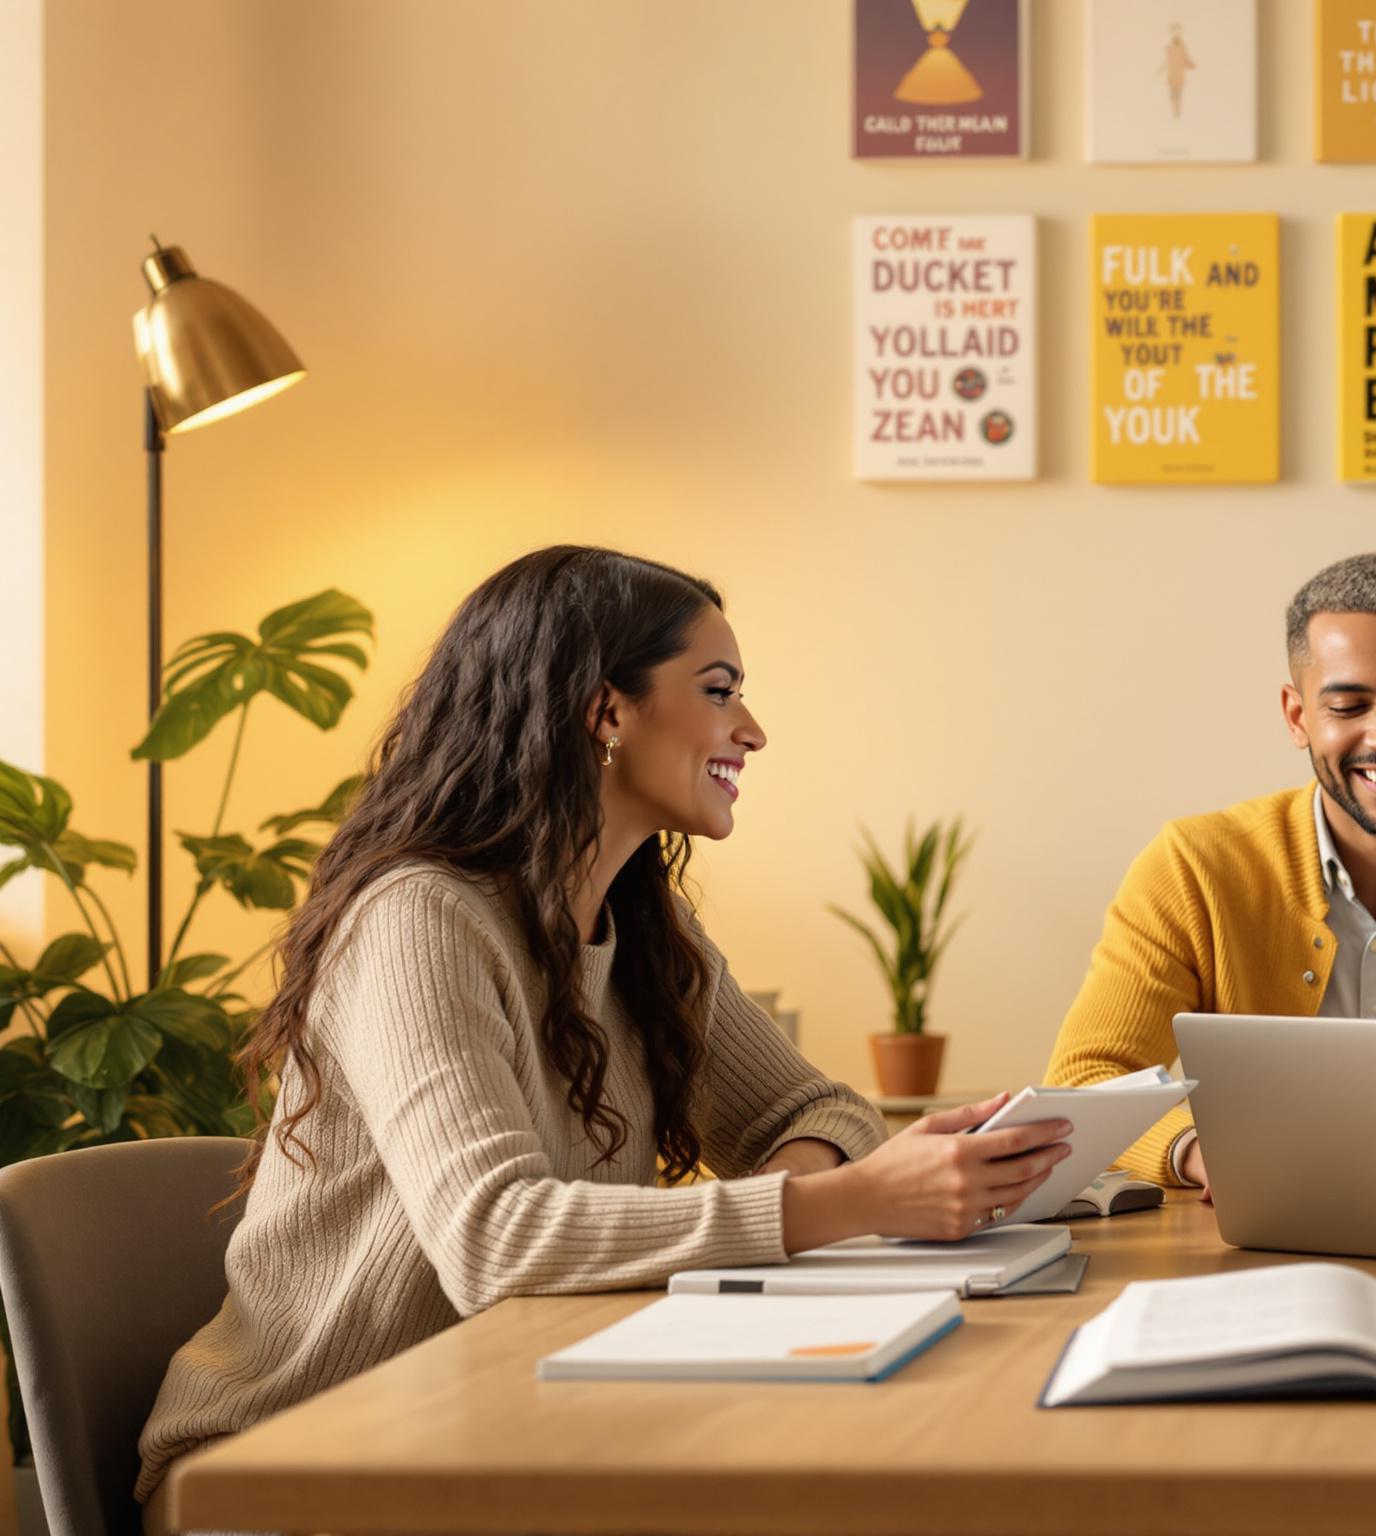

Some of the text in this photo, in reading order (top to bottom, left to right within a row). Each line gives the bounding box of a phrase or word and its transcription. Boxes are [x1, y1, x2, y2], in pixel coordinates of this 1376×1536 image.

[872, 260, 1015, 292] DUCKET
[1102, 245, 1260, 288] FULK AND
[934, 299, 955, 319] IS
[1104, 290, 1185, 312] YOU'RE
[870, 325, 1020, 358] YOLLAID
[1167, 314, 1213, 338] THE
[1121, 343, 1183, 366] YOUT
[869, 368, 940, 400] YOU
[1124, 364, 1257, 401] OF THE
[871, 411, 965, 443] ZEAN
[1104, 405, 1201, 445] YOUK
